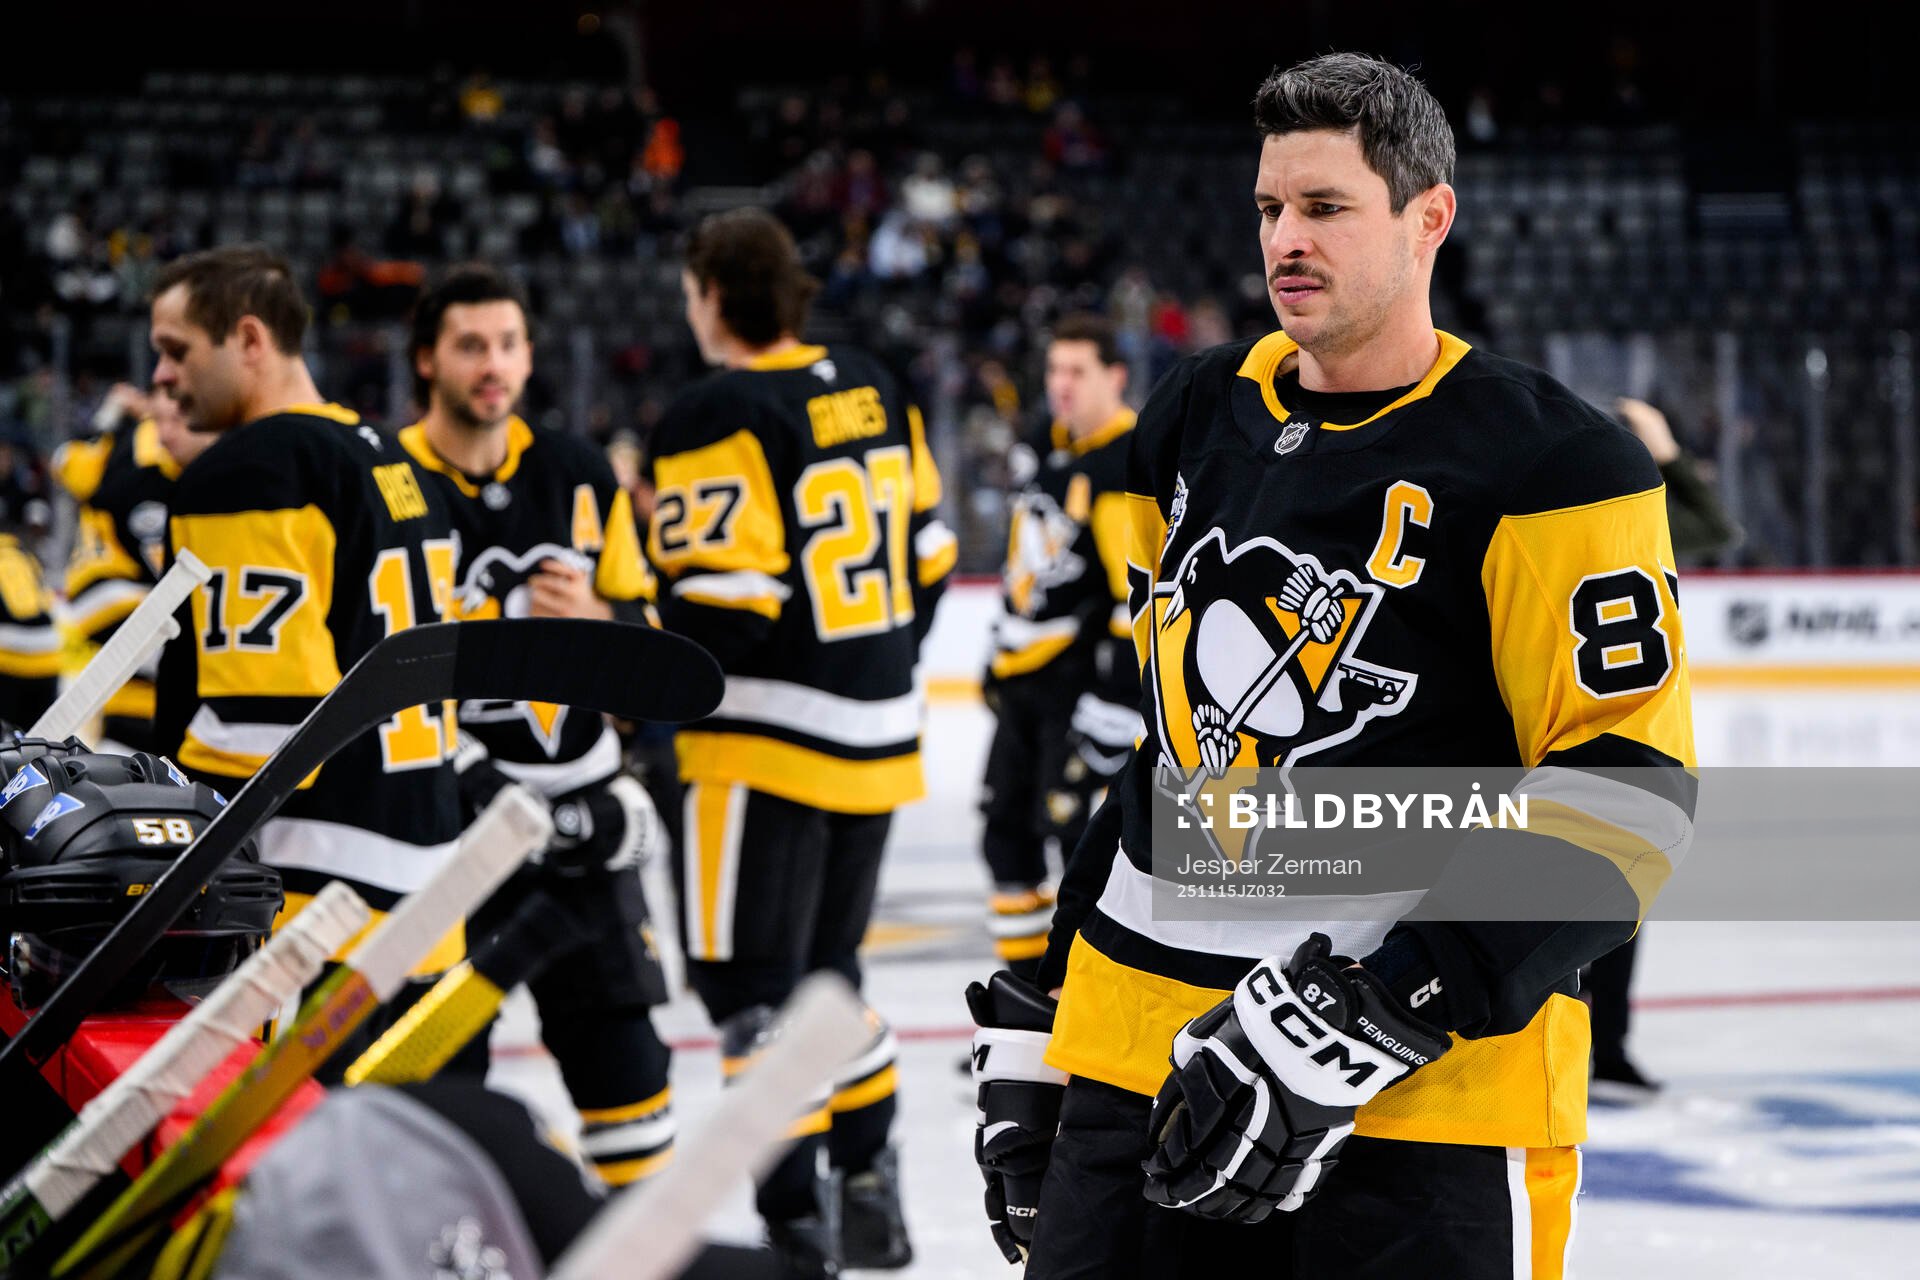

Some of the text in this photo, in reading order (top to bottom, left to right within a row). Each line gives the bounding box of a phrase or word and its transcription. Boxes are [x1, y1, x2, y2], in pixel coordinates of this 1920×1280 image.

[652, 474, 747, 560] 27
[791, 445, 915, 643] 27
[1365, 480, 1434, 589] C
[202, 566, 308, 655] 17
[1569, 559, 1684, 700] 8
[132, 817, 195, 845] 58
[1246, 966, 1380, 1088] CCM
[1303, 983, 1337, 1011] 87
[1357, 1016, 1429, 1066] PENGUINS
